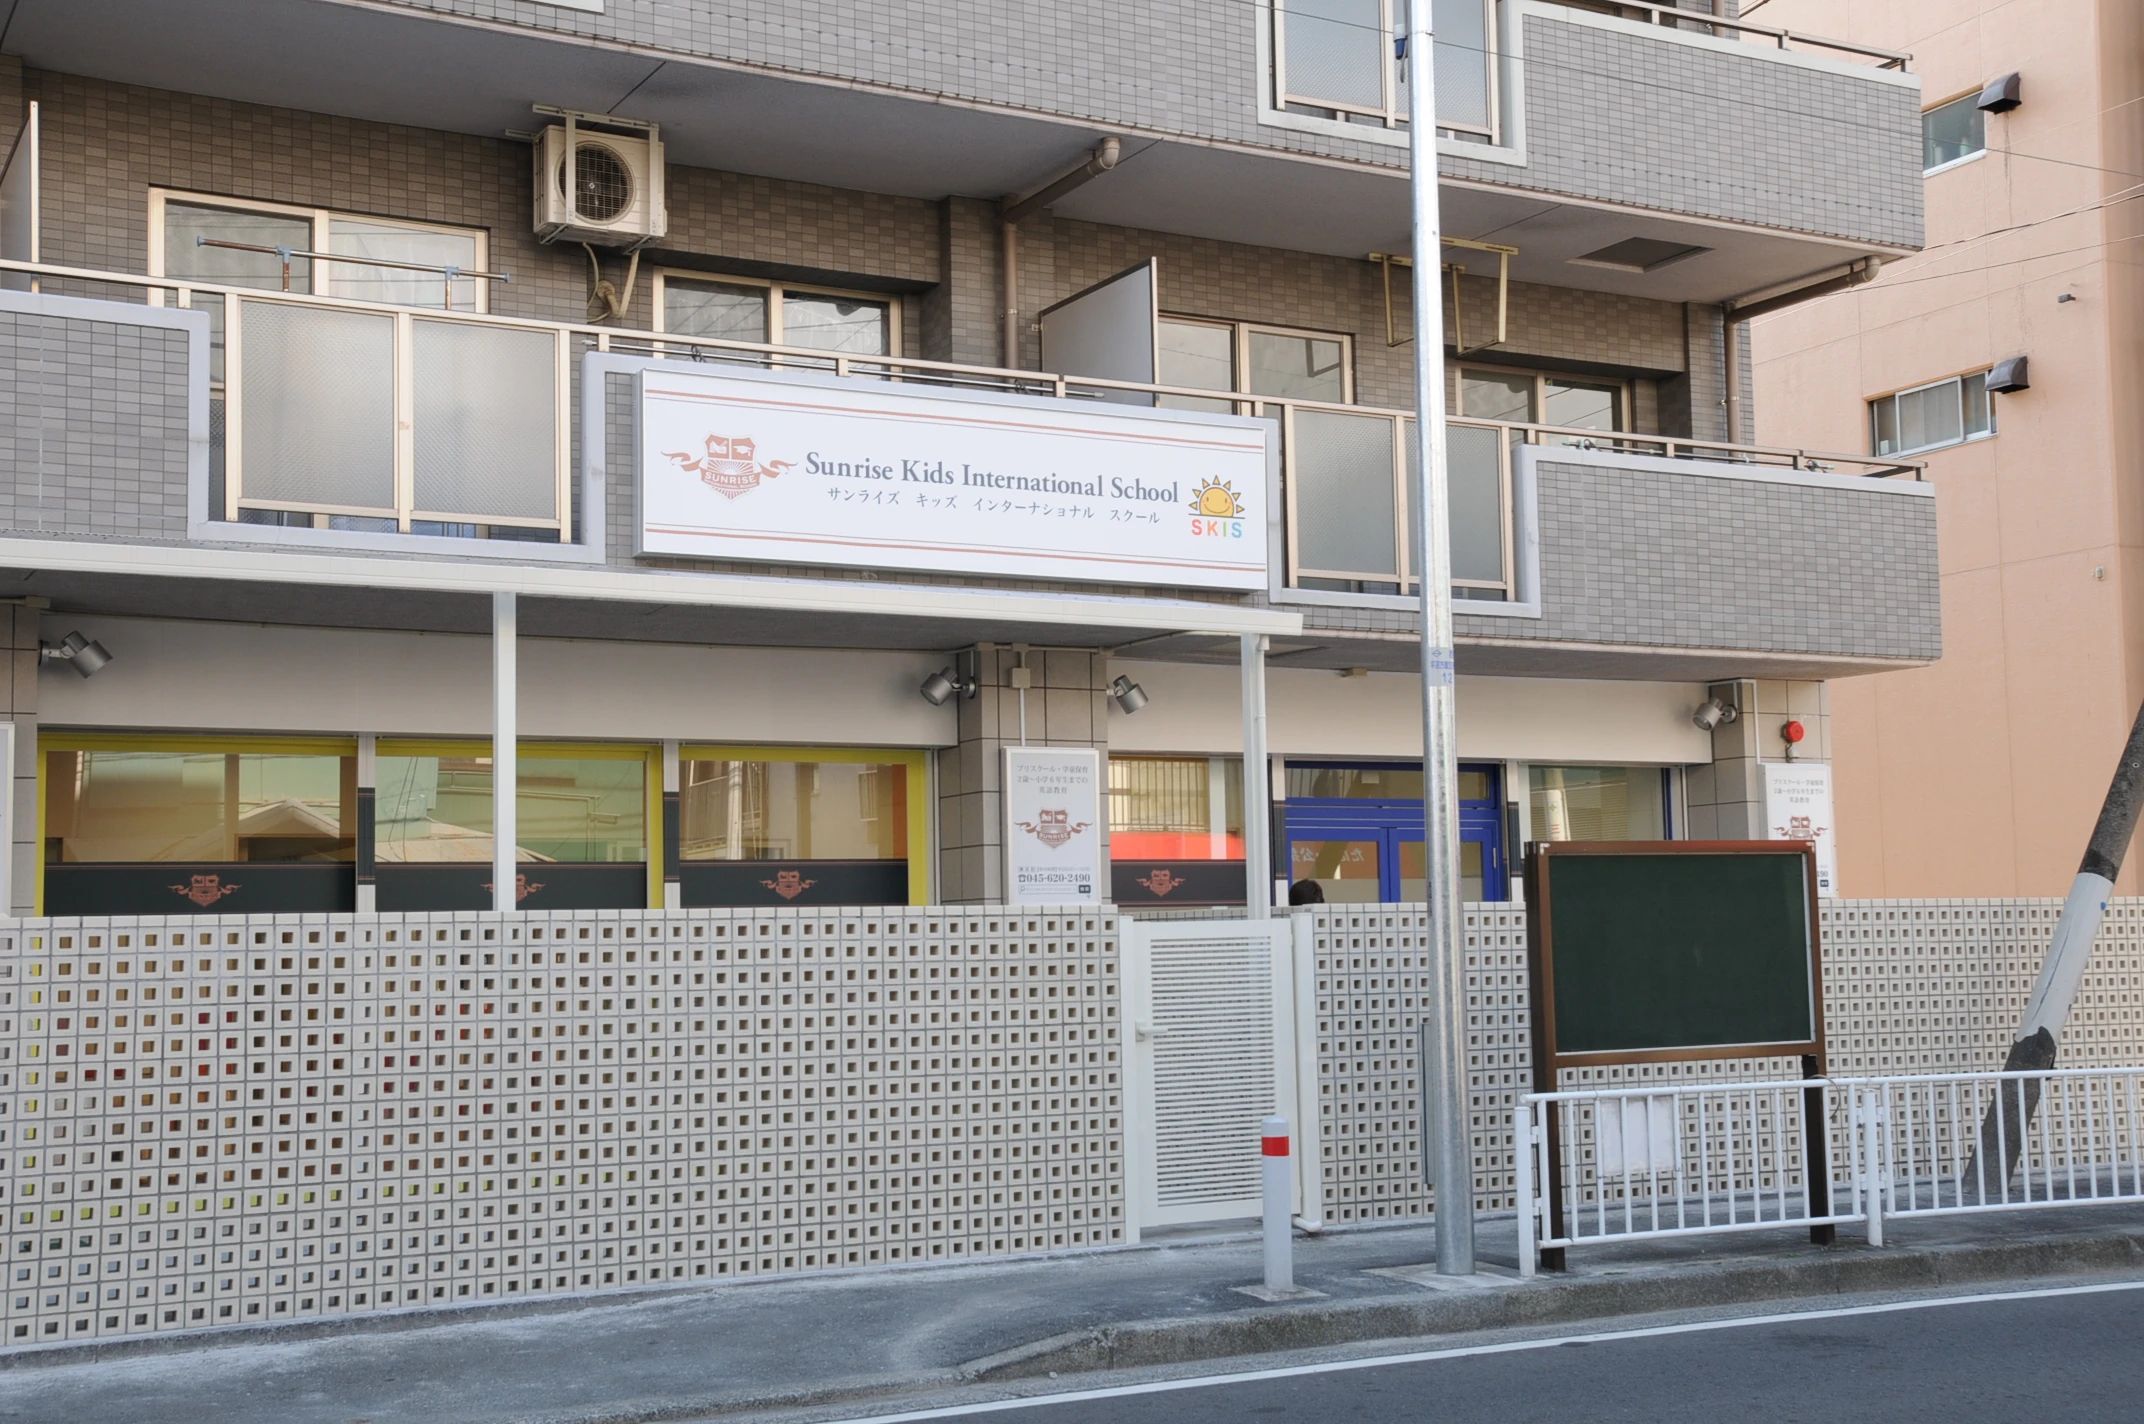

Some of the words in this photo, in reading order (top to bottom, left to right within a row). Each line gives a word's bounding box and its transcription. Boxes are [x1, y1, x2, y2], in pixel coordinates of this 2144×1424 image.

[704, 471, 757, 486] SUNRISE
[805, 451, 893, 481] Sunrise
[900, 458, 955, 485] Kids
[962, 464, 1103, 498] International
[1110, 476, 1179, 503] School
[827, 487, 900, 505] サンライズ
[915, 492, 957, 509] キッズ
[973, 497, 1095, 519] インターナショナル
[1109, 508, 1160, 524] スクール
[1191, 518, 1243, 538] SKIS
